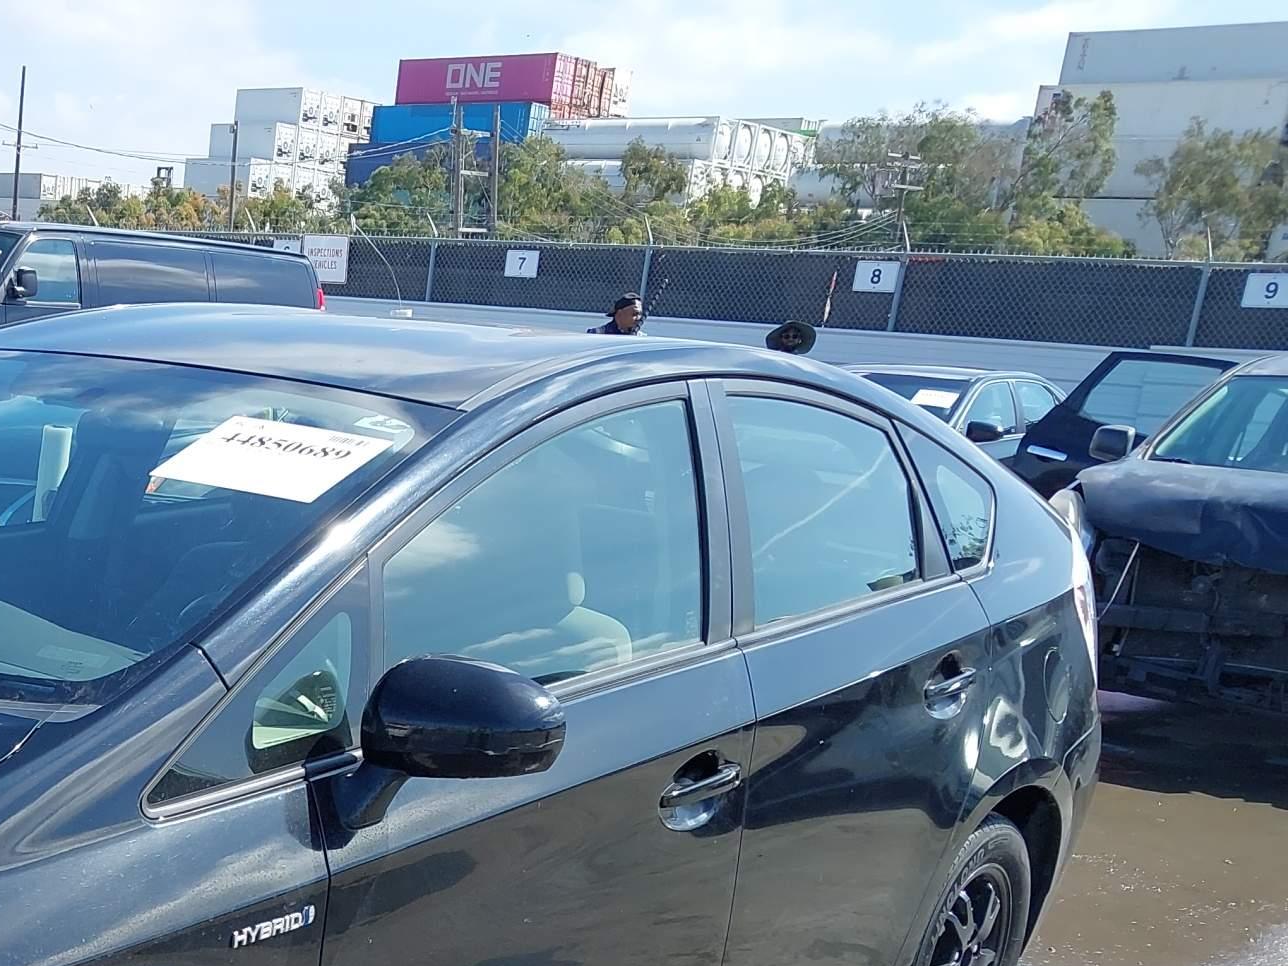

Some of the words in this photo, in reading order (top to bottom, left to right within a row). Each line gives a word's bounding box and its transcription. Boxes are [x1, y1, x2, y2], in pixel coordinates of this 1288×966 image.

[446, 62, 502, 88] ONE
[307, 247, 343, 258] INSPECTIONS
[518, 256, 527, 270] 7
[870, 268, 882, 284] 8
[1264, 282, 1279, 299] 9
[221, 432, 352, 460] 44850689
[233, 911, 304, 949] HYBRID
